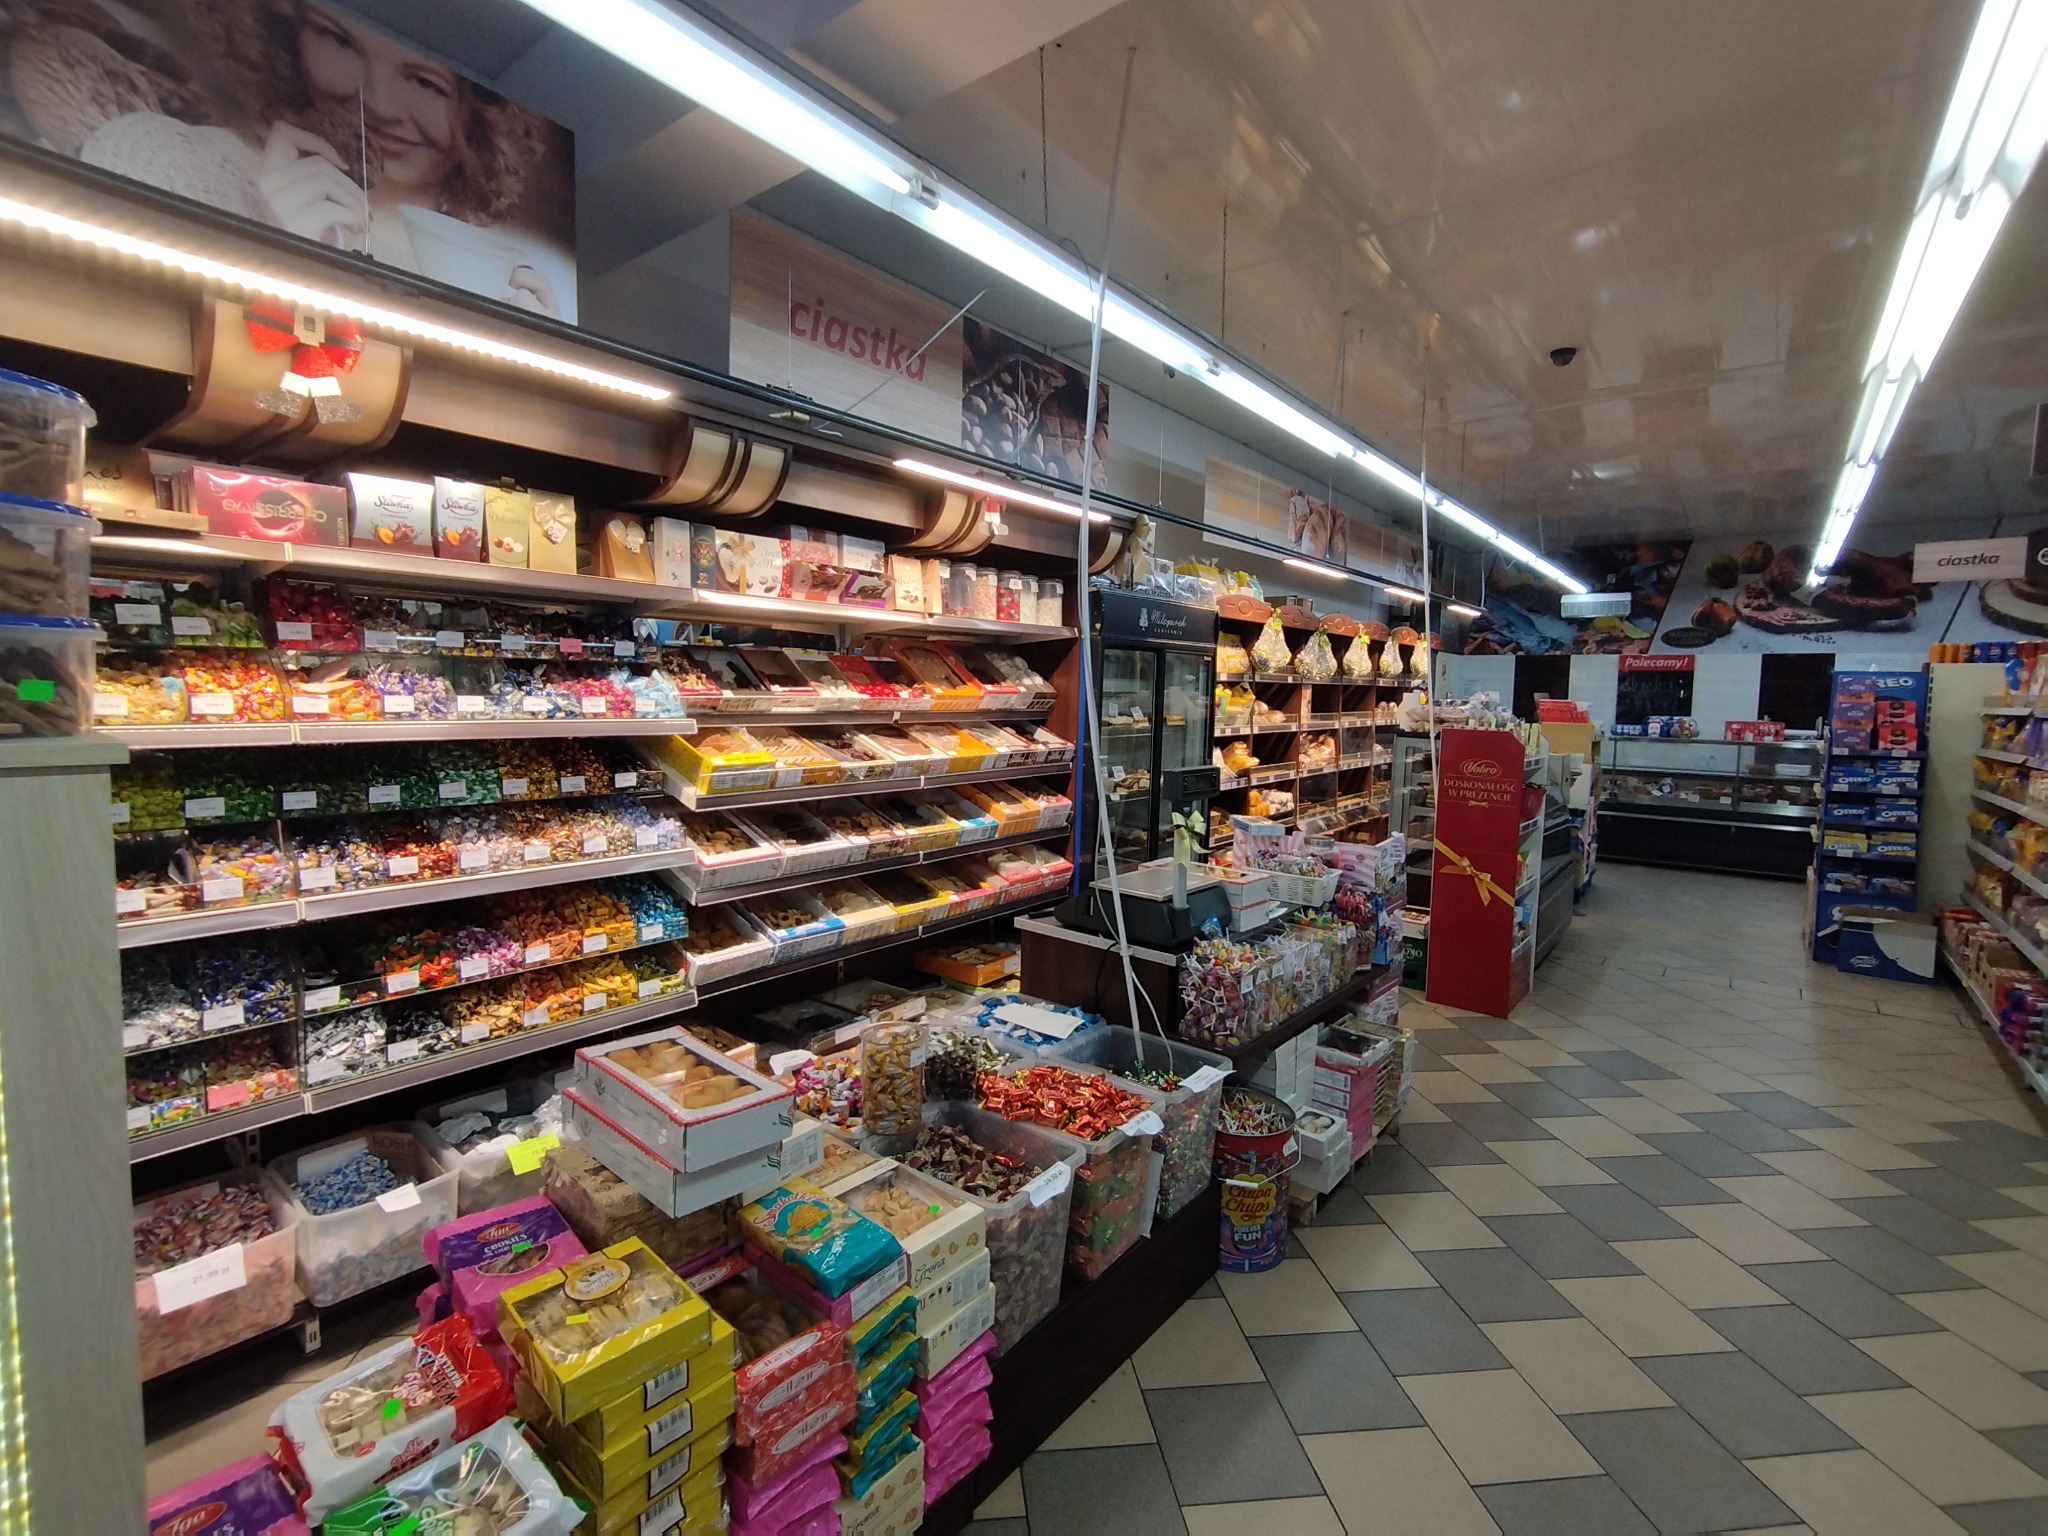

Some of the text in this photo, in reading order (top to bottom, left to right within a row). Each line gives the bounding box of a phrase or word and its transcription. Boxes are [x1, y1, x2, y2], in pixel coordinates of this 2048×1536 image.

[790, 298, 927, 381] ciastka
[1937, 552, 2000, 567] ciastka
[1624, 656, 1688, 668] Polecamy!
[1875, 676, 1914, 688] REO
[1464, 760, 1498, 775] Vobro
[1443, 778, 1517, 793] DOSKONAŁOŚĆ
[1448, 788, 1511, 802] W PREZENCIE
[372, 1135, 413, 1149] ROSH
[1228, 1185, 1273, 1200] Chupa
[1224, 1197, 1270, 1213] Chups
[484, 1234, 528, 1253] COOKIES
[1234, 1231, 1262, 1242] FUN
